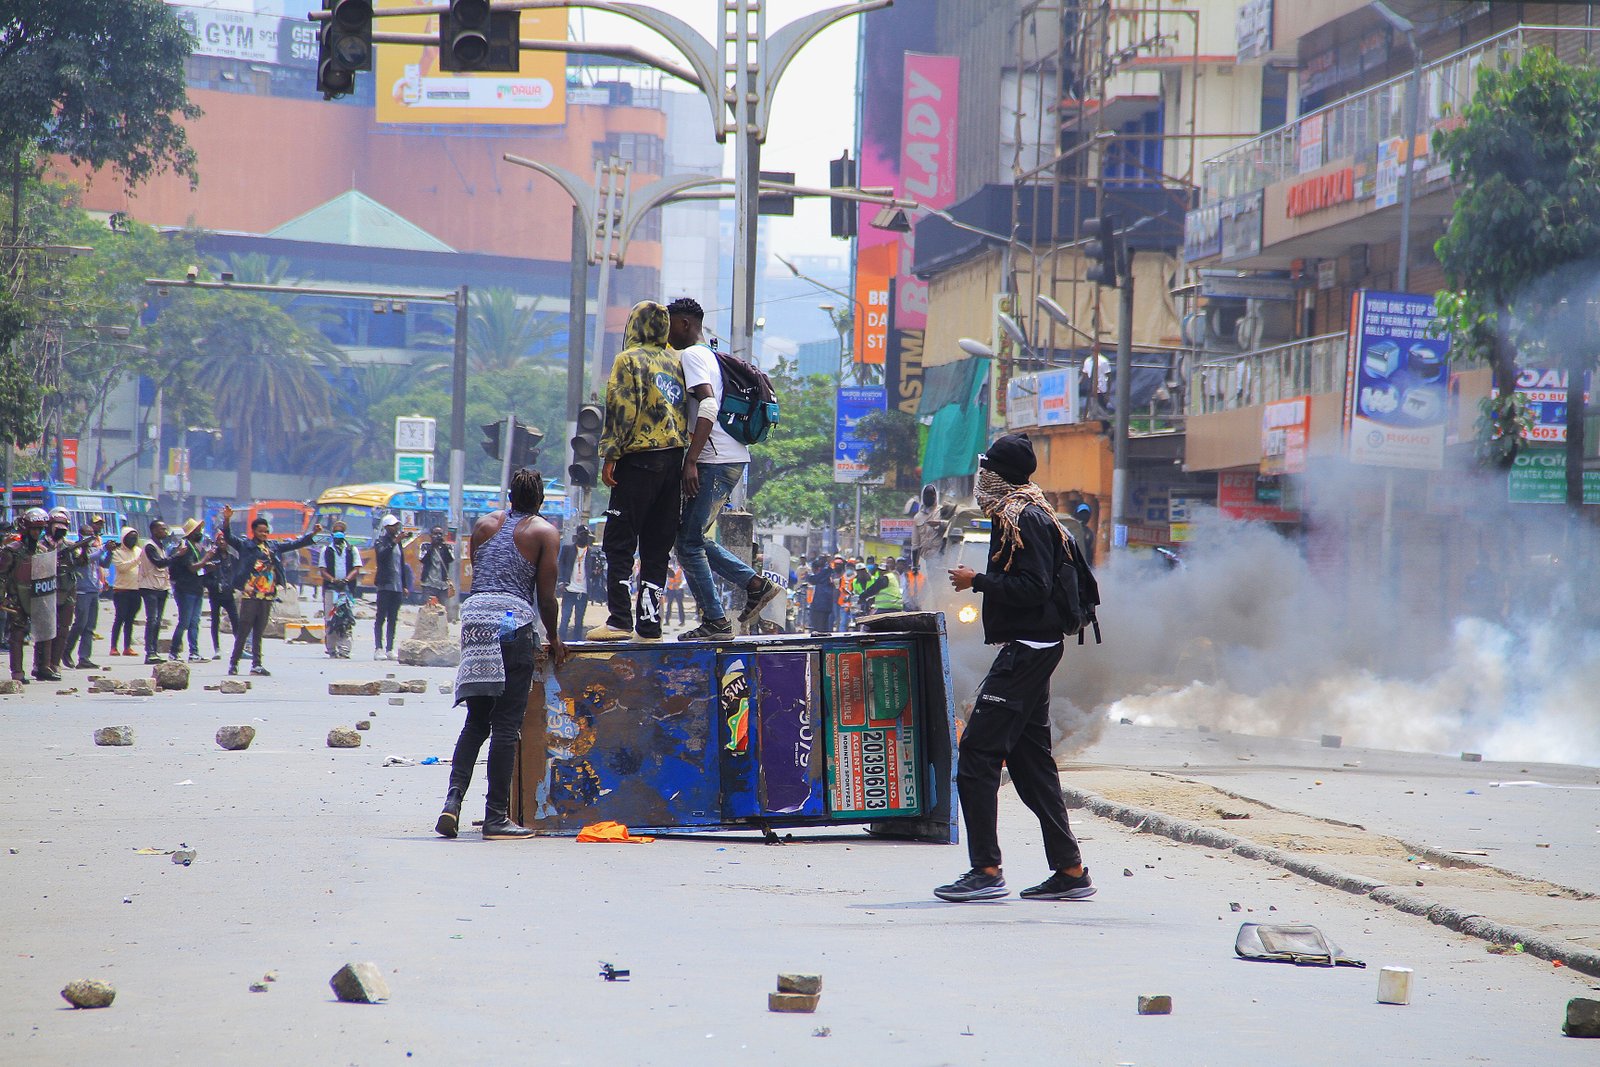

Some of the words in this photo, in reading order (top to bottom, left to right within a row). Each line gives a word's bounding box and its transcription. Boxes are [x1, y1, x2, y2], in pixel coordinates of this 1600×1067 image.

[205, 22, 254, 48] GYM
[1405, 303, 1427, 317] STOP
[1380, 315, 1411, 328] THERMAL
[867, 334, 885, 349] ST
[1532, 427, 1558, 438] 603
[35, 579, 57, 593] POLIC
[764, 571, 789, 590] POLIC
[842, 659, 850, 680] LINES
[853, 676, 861, 702] AIRTEL
[843, 681, 852, 720] AVAILABLE
[853, 734, 861, 773] AGENT
[863, 732, 887, 809] 2039603
[855, 776, 863, 808] NAME
